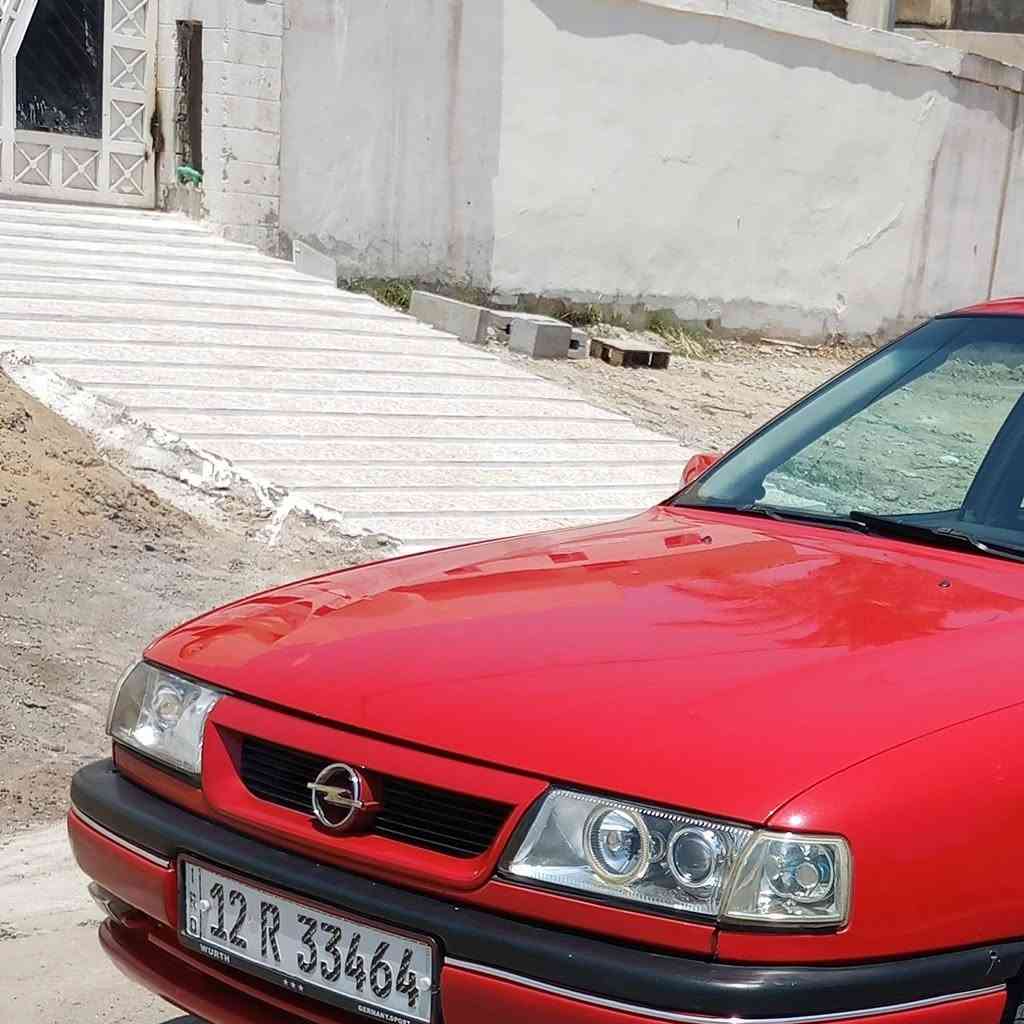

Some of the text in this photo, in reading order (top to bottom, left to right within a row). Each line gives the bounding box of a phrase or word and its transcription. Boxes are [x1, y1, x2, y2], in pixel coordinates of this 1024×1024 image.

[210, 883, 417, 1009] 12 R 33464
